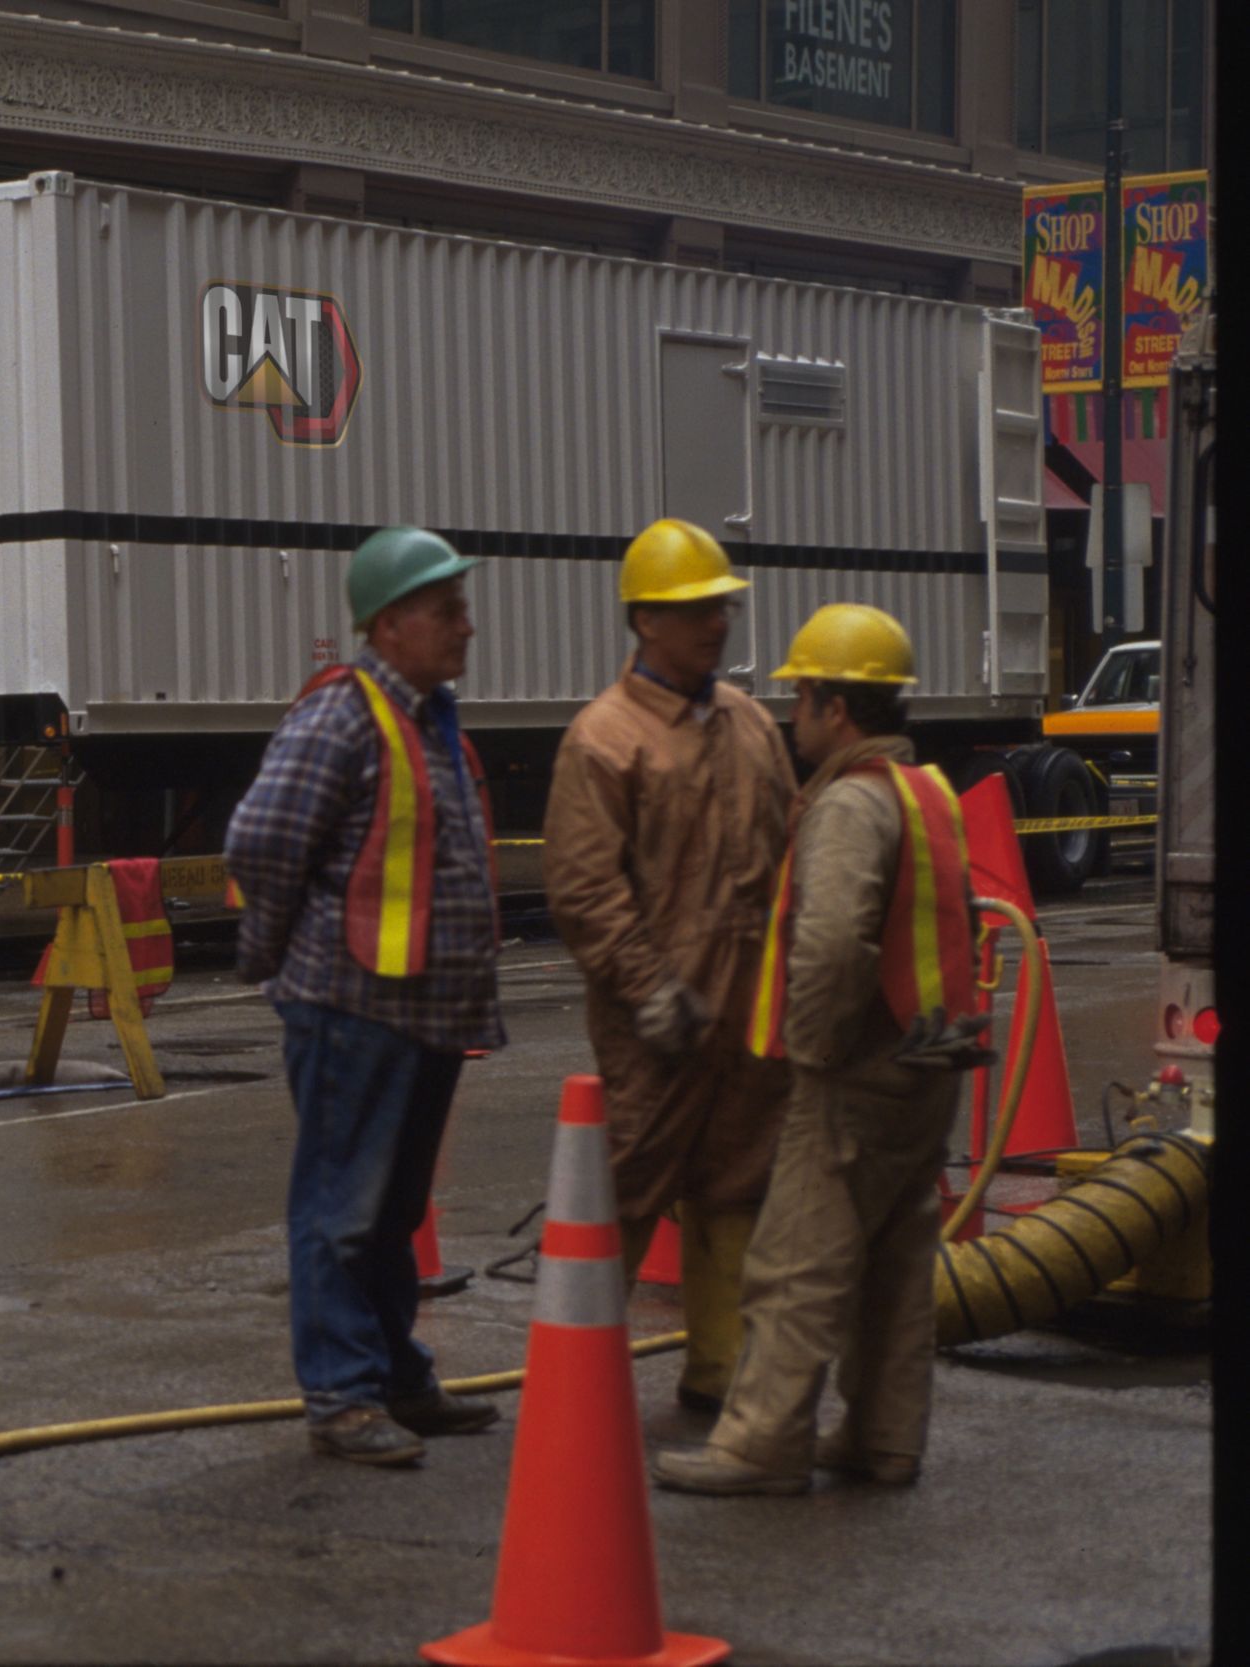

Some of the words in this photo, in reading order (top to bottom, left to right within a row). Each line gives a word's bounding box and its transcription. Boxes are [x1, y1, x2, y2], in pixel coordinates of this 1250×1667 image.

[784, 0, 892, 53] FILENE'S
[784, 42, 892, 99] BASEMENT
[1035, 212, 1095, 253] SHOP
[1136, 202, 1199, 244] SHOP
[1032, 254, 1096, 359] MADISON
[203, 285, 322, 406] CAT
[1041, 342, 1078, 361] TREET
